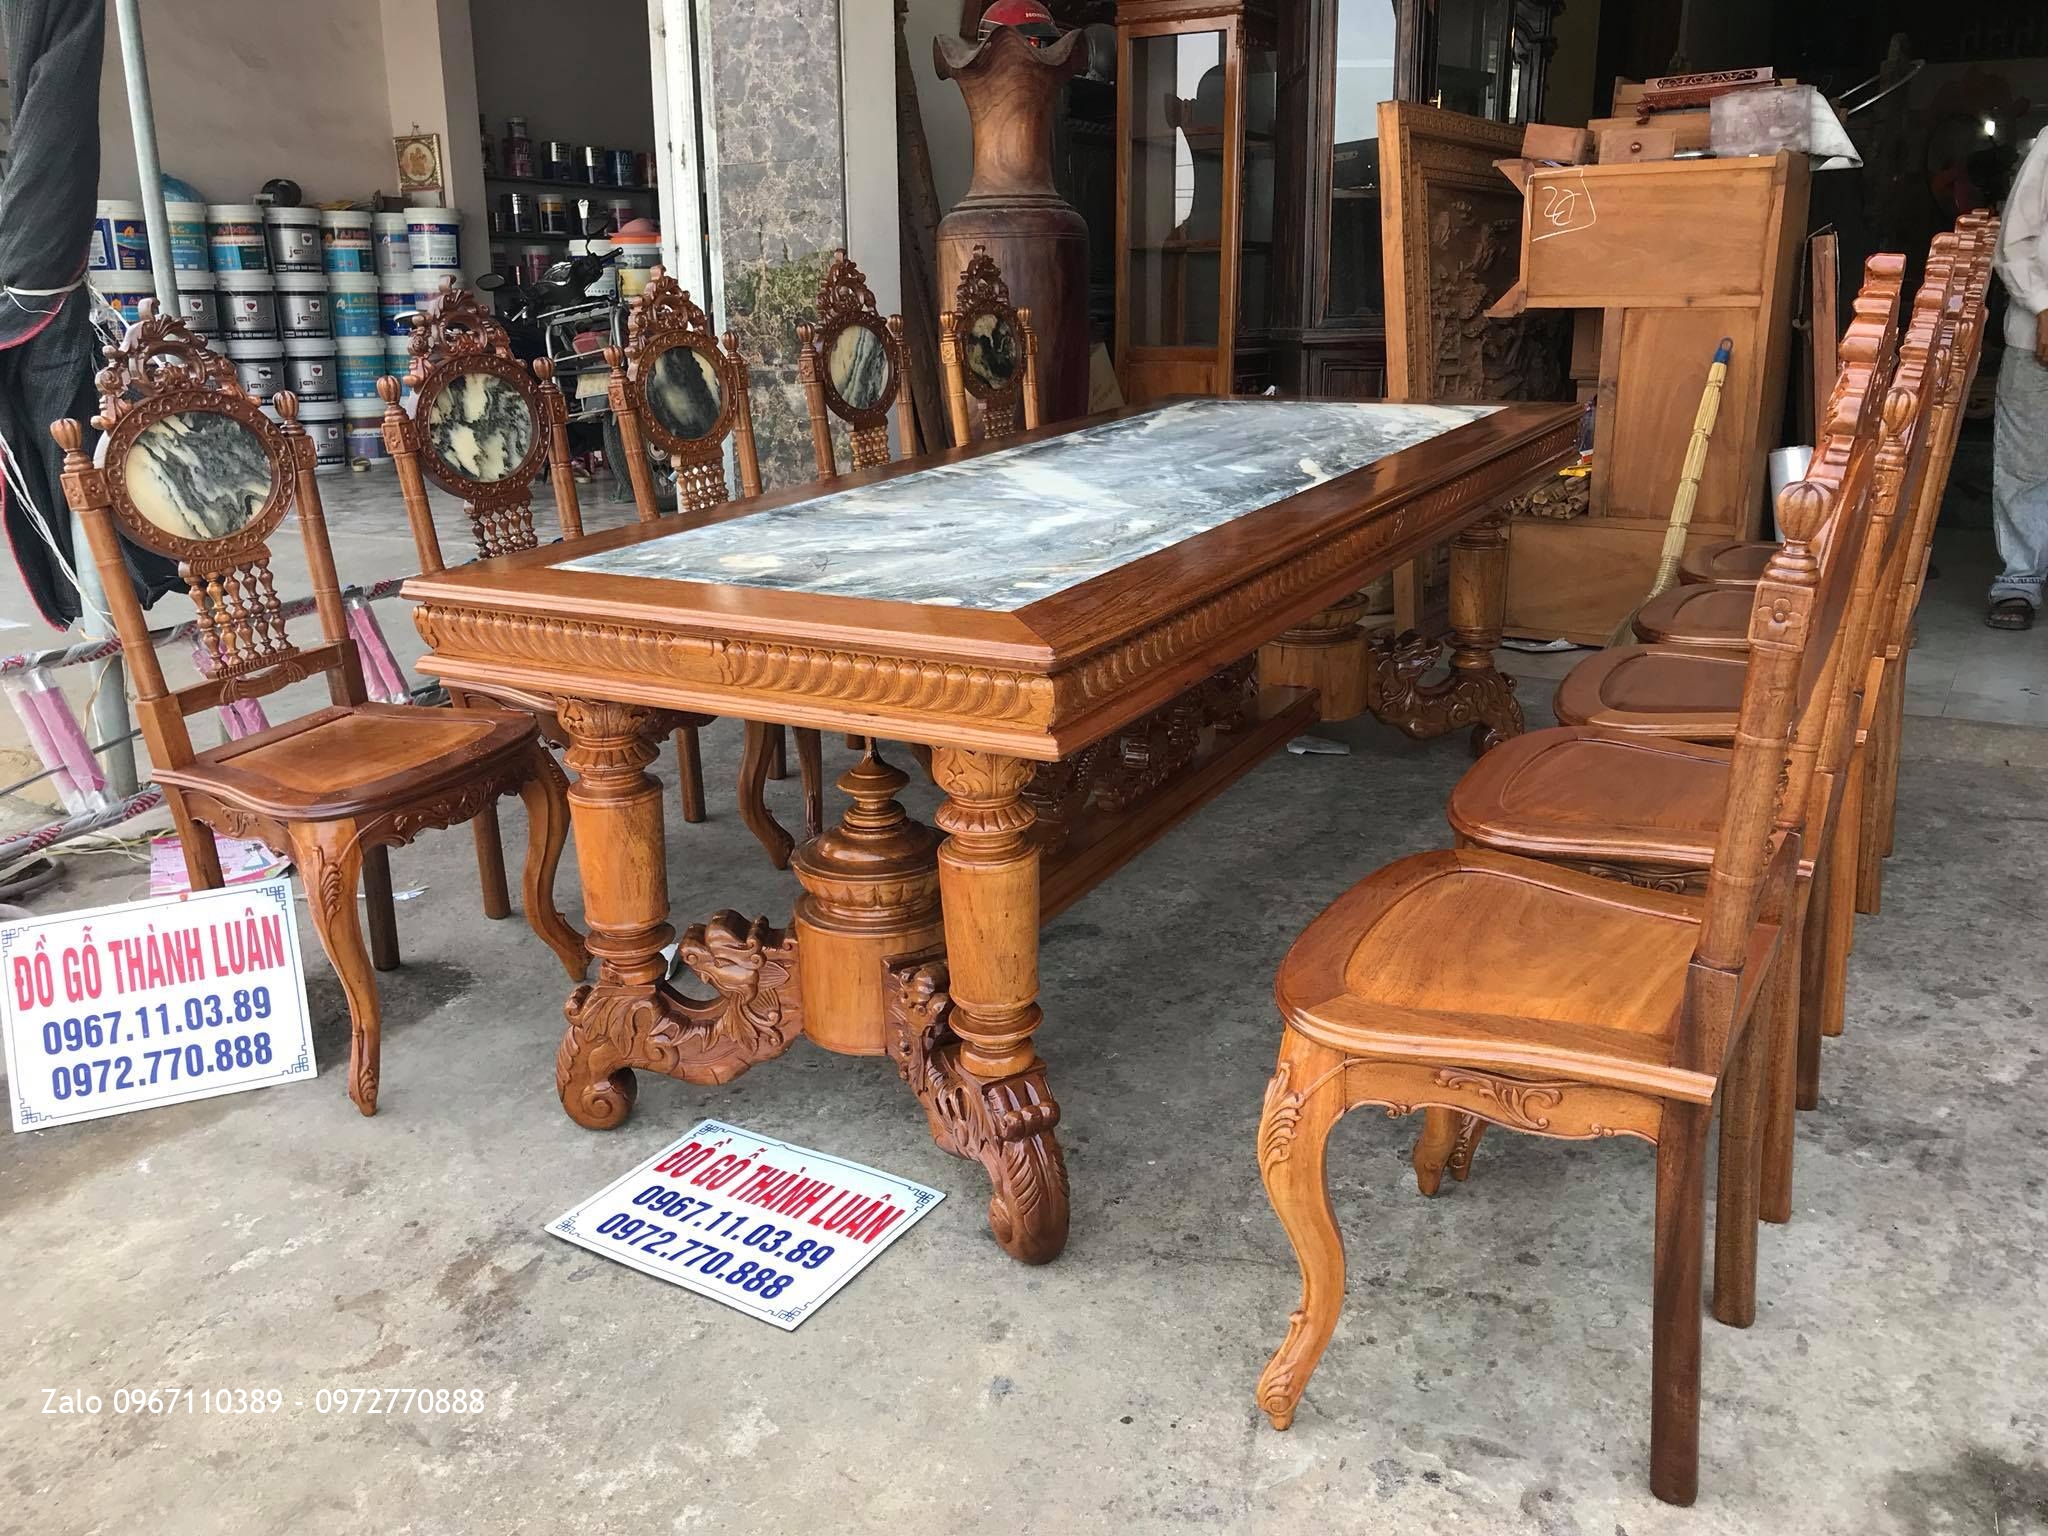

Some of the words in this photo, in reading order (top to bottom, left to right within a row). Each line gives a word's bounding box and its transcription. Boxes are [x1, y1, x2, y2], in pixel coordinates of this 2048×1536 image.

[14, 940, 54, 1011] ĐỒ
[62, 926, 103, 1003] GỖ
[108, 924, 205, 994] THÀNH
[210, 907, 286, 978] LUÂN
[42, 986, 271, 1055] 0967.11.03.89
[52, 1032, 273, 1100] 0972.770.888
[654, 1137, 733, 1178] ĐỒ
[690, 1147, 768, 1191] GỖ
[727, 1164, 834, 1220] THÀNH
[807, 1189, 905, 1245] LUÂN
[595, 1212, 794, 1300] 0972.770.888
[632, 1184, 835, 1269] 0967.11.03.89
